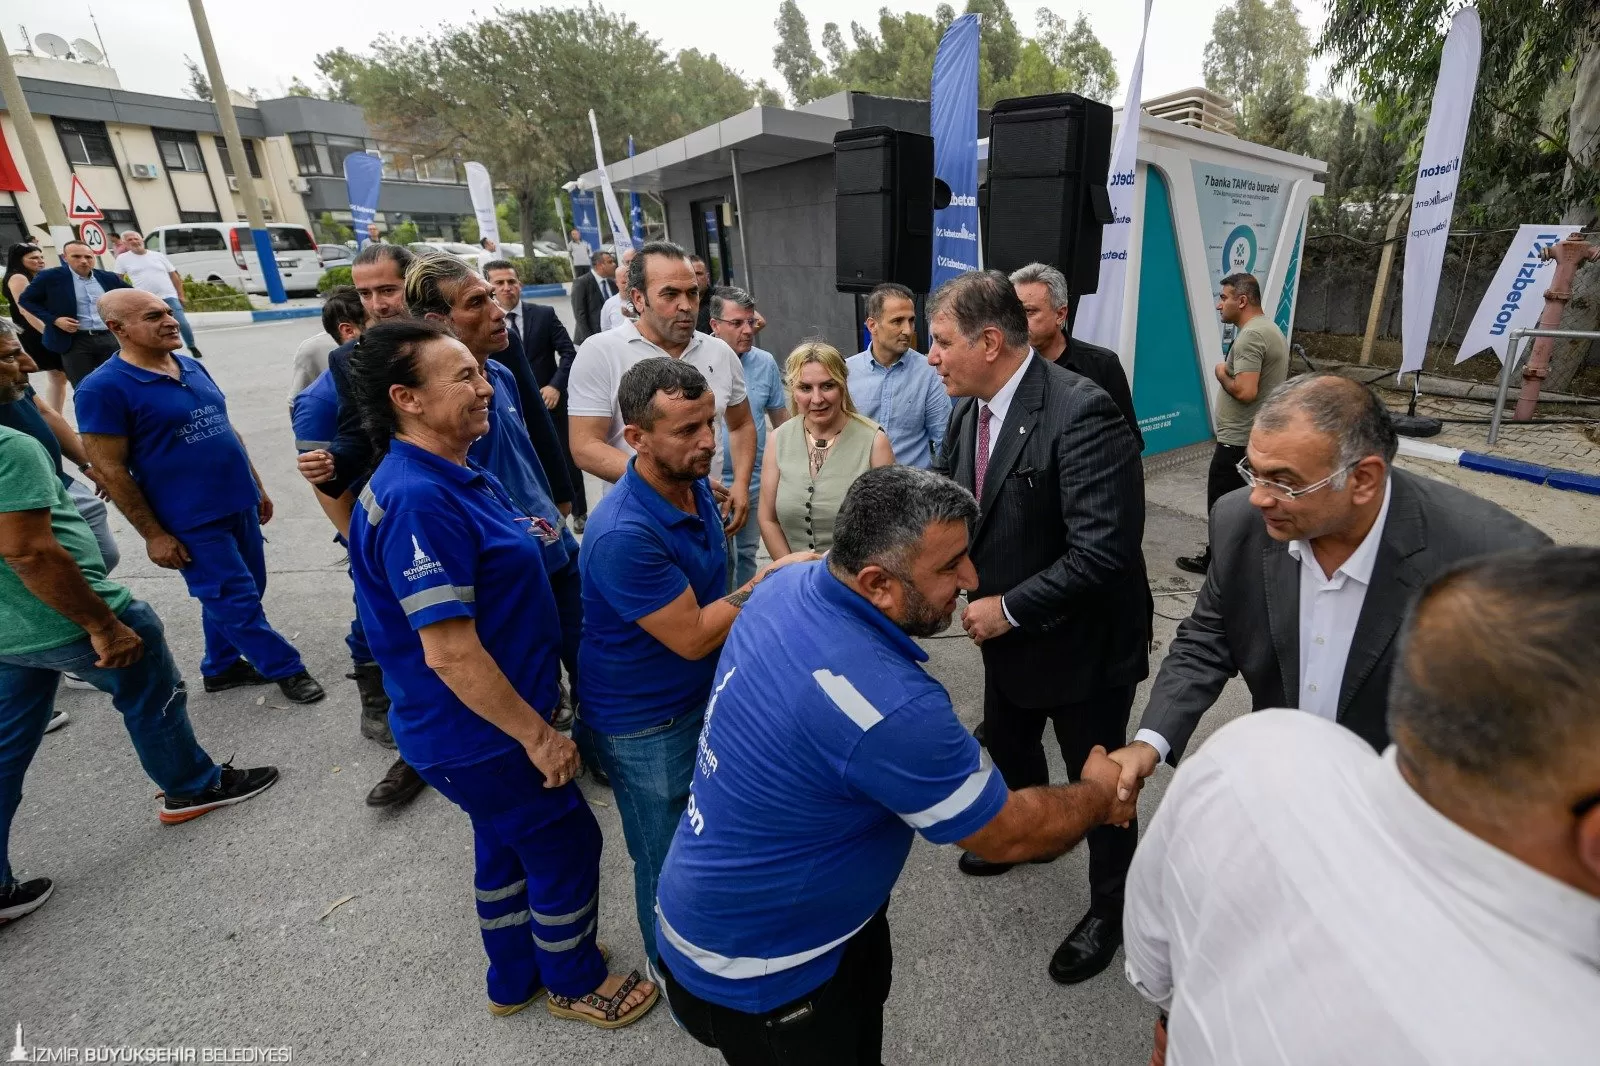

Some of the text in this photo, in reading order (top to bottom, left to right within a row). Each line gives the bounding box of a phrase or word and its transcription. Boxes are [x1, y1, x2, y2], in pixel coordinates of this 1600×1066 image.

[1204, 175, 1210, 186] 7
[1210, 176, 1231, 189] banka
[1256, 181, 1280, 194] burada!
[86, 229, 102, 245] 20
[1489, 262, 1544, 336] izbeton
